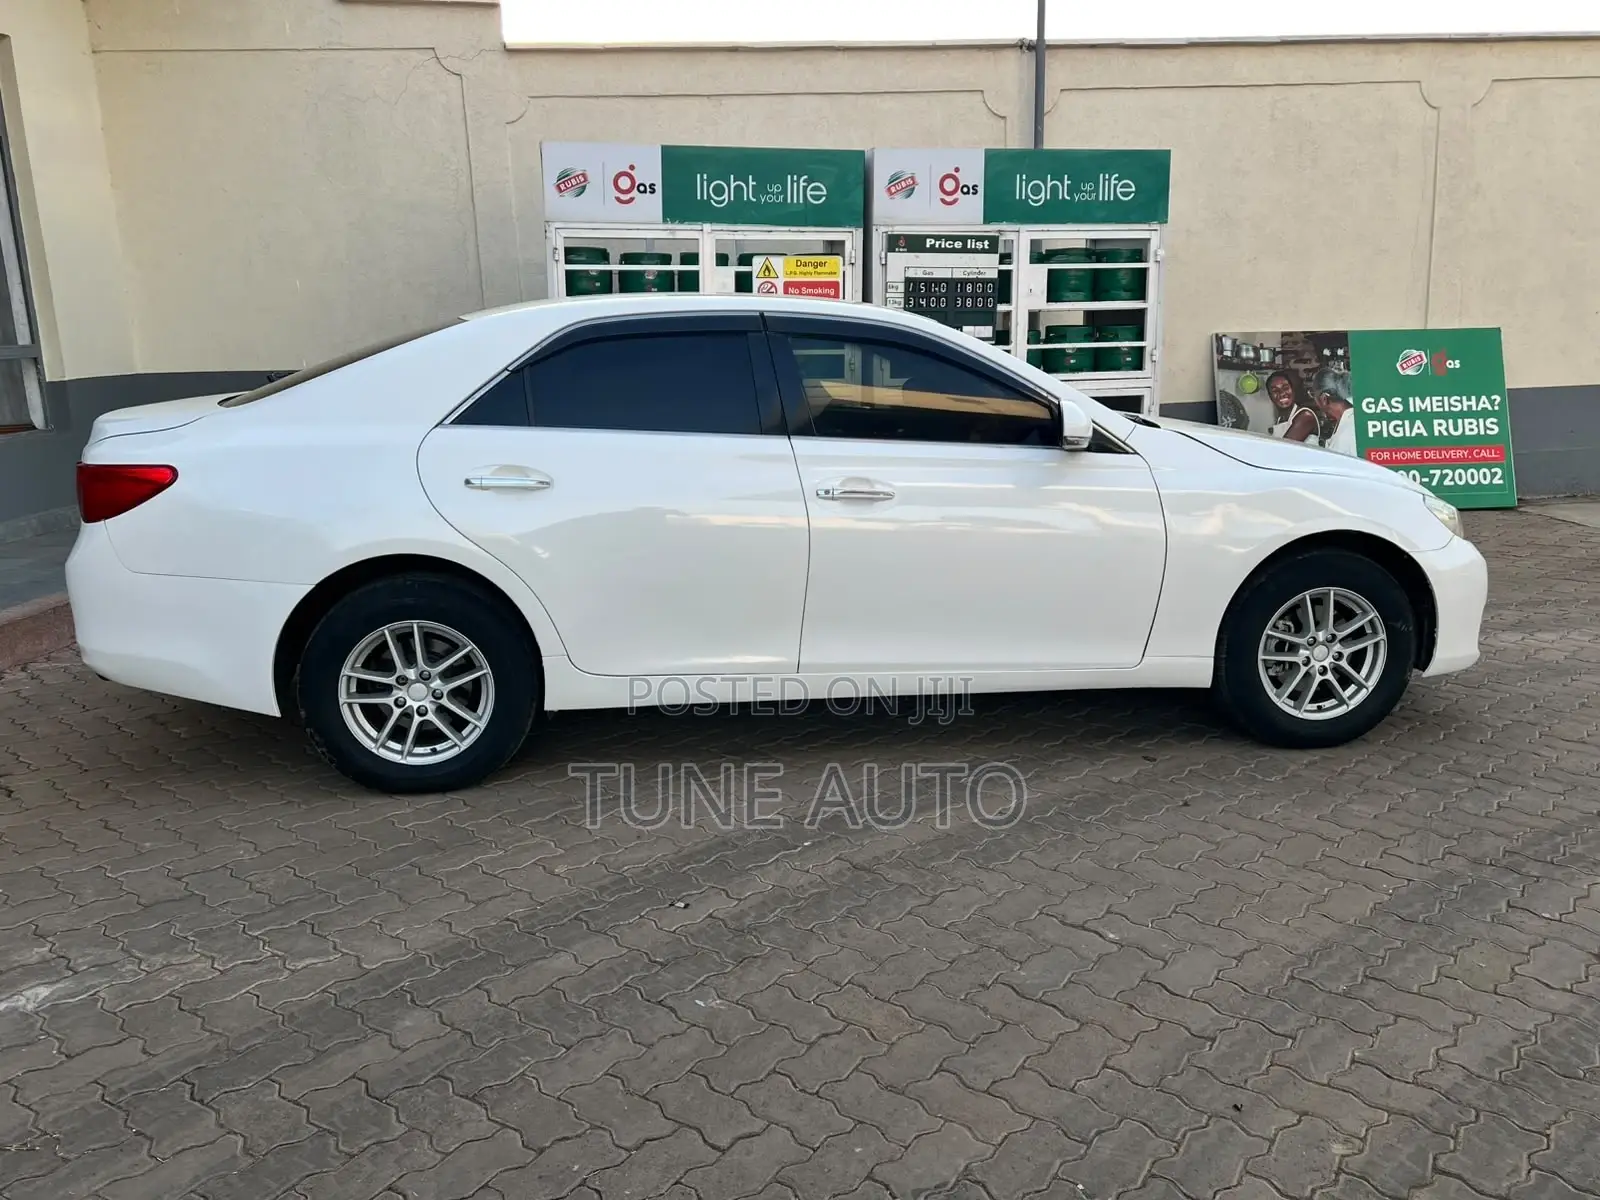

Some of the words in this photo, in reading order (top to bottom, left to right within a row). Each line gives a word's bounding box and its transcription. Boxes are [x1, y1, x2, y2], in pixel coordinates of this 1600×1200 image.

[559, 174, 585, 192] RUBIS
[890, 177, 914, 194] RUBIS
[1081, 182, 1095, 194] up
[1099, 173, 1136, 201] life
[696, 173, 757, 207] light
[767, 184, 782, 196] up
[787, 174, 828, 205] life
[1016, 173, 1072, 206] light
[759, 193, 785, 205] your
[1074, 190, 1097, 202] your
[925, 238, 963, 248] Price
[967, 239, 990, 249] list
[795, 259, 828, 269] Danger
[788, 287, 800, 295] No
[801, 286, 835, 295] Smoking
[957, 282, 994, 293] 1800
[956, 297, 994, 308] 3800
[1402, 356, 1422, 369] RUBIS
[1361, 398, 1403, 414] GAS
[1409, 395, 1501, 413] IMEISHA?
[1367, 419, 1428, 438] PIGIA
[1433, 418, 1500, 436] RUBIS
[1370, 451, 1391, 461] FOR
[1392, 450, 1422, 460] HOME
